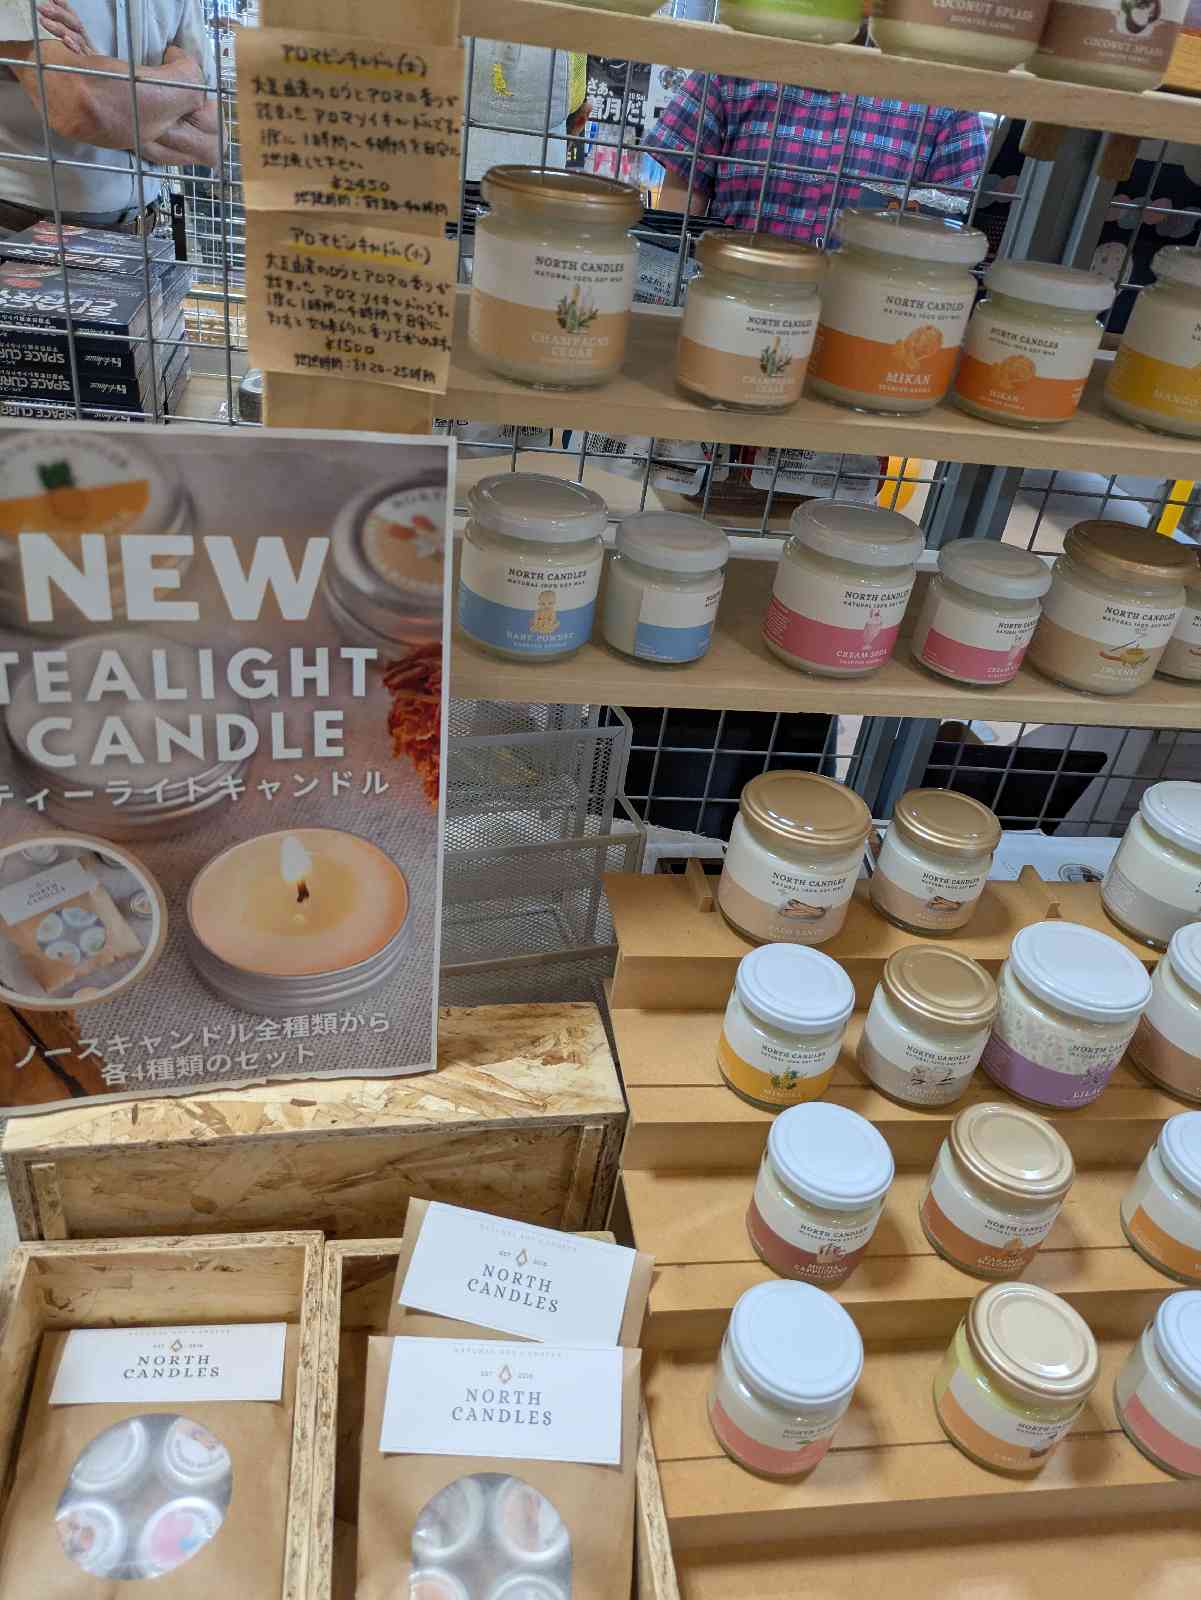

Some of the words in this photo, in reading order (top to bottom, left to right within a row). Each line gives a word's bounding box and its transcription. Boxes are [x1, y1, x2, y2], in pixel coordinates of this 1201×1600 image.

[534, 255, 578, 271] NORTH
[579, 262, 625, 273] CANDLES
[886, 296, 927, 310] NORTH
[24, 351, 66, 364] SPACE
[30, 379, 71, 391] SPACE
[886, 371, 931, 385] MIKAN
[36, 408, 75, 420] SPACE
[18, 532, 331, 623] NEW
[508, 566, 544, 581] NORTH
[546, 569, 588, 582] CANDLES
[846, 590, 881, 602] NORTH
[1103, 606, 1140, 620] NORTH
[835, 648, 869, 660] CREAM
[26, 709, 346, 768] CANDLE
[772, 871, 806, 887] NORTH
[807, 877, 848, 888] CANDLES
[922, 871, 949, 884] NORTH
[15, 1010, 391, 1070] ノースキャンドル全種類から
[762, 1044, 790, 1058] NORTH
[906, 1044, 936, 1060] NORTH
[101, 1045, 318, 1087] 各4種類のセット
[800, 1223, 832, 1238] NORTH
[986, 1218, 1017, 1232] NORTH
[482, 1263, 553, 1294] NORTH
[466, 1278, 559, 1313] CANDLES
[136, 1354, 211, 1366] NORTH
[123, 1366, 221, 1380] CANDLES
[464, 1387, 543, 1406] NORTH
[451, 1406, 553, 1427] CANDLES
